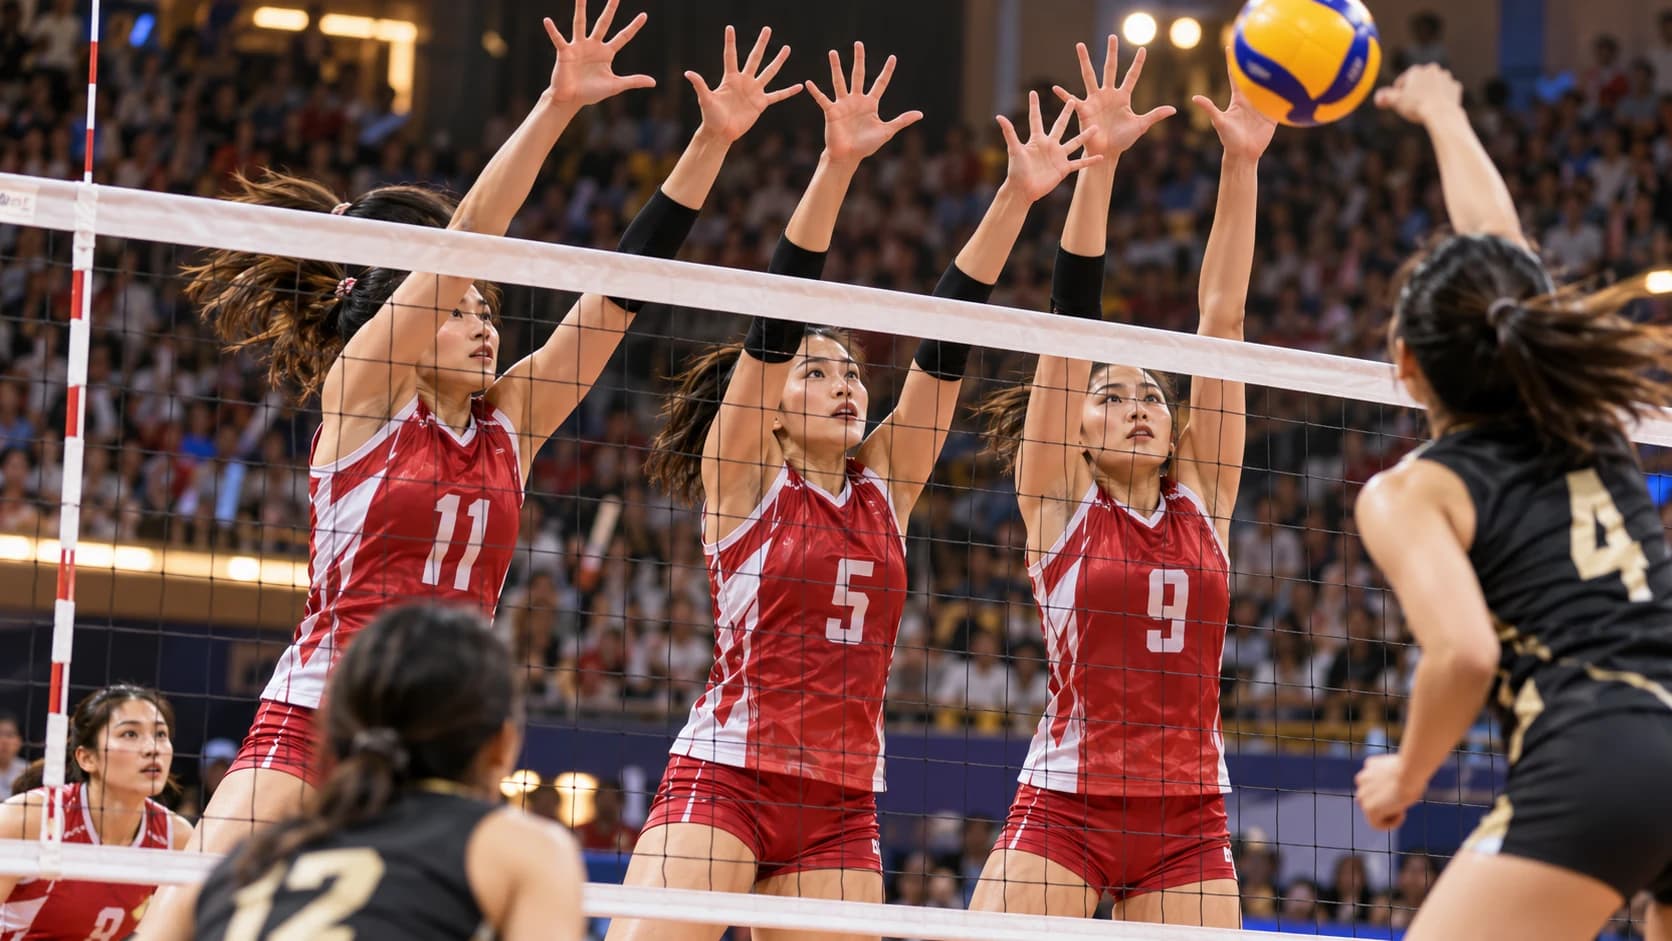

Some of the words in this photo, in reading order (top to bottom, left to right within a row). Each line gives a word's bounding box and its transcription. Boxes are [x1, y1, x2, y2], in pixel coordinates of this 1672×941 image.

[422, 493, 490, 591] 11
[1566, 468, 1653, 602] 4
[825, 558, 874, 645] 5
[1146, 569, 1189, 653] 9
[224, 847, 386, 941] 12
